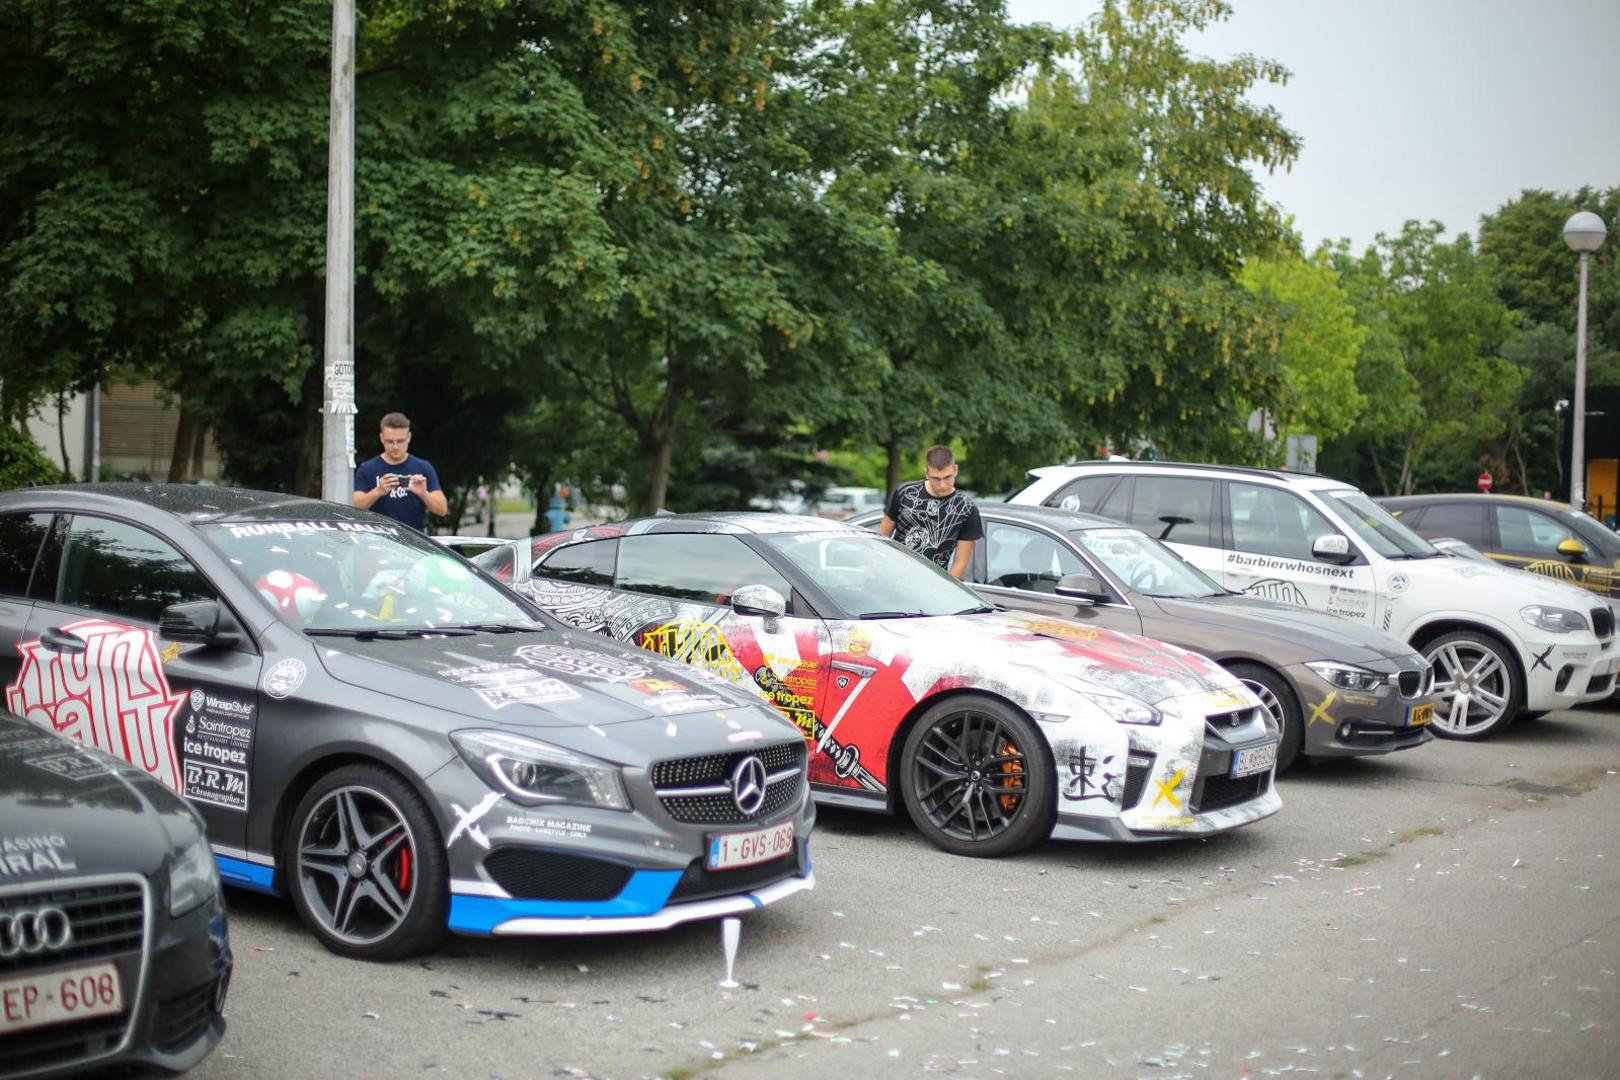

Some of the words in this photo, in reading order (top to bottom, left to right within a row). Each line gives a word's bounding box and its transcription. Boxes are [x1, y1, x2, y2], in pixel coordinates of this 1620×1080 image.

[230, 522, 337, 538] RUNBALL
[338, 522, 398, 536] RALLY
[1227, 553, 1355, 579] #barbierwhosnext
[776, 691, 814, 706] tropez
[199, 716, 251, 739] Saintropez
[184, 737, 203, 755] ice
[203, 742, 246, 764] tropez
[186, 765, 245, 794] B.R.M
[507, 816, 545, 827] BADCHIX
[547, 820, 592, 832] MAGAZINE
[0, 835, 65, 852] ASINO
[723, 827, 792, 862] 1-GVS-069
